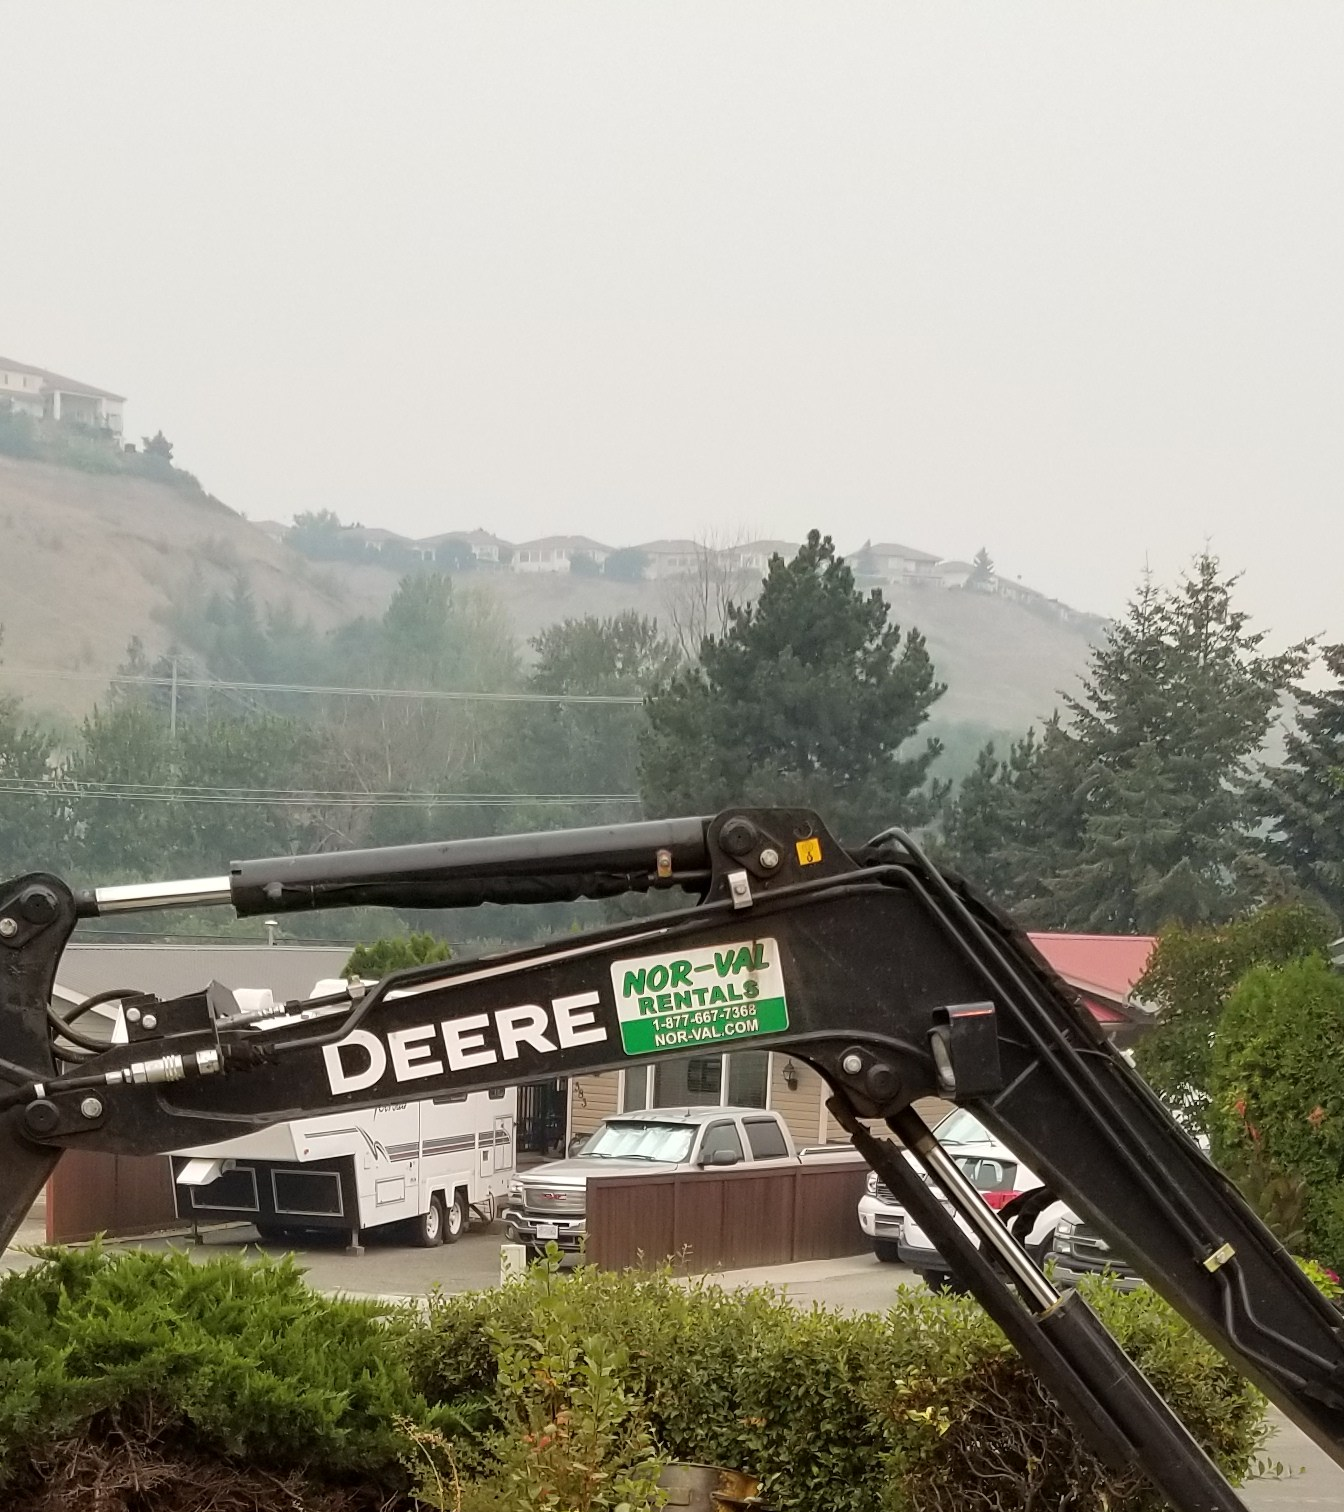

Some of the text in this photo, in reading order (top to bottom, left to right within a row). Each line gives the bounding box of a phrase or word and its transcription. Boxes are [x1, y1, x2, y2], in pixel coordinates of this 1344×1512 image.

[622, 943, 770, 998] NOR-VAL
[638, 979, 760, 1016] RENTALS
[652, 1003, 757, 1031] 1-877-667-7368
[654, 1018, 759, 1047] NOR-VAL.COM
[322, 991, 607, 1095] DEERE
